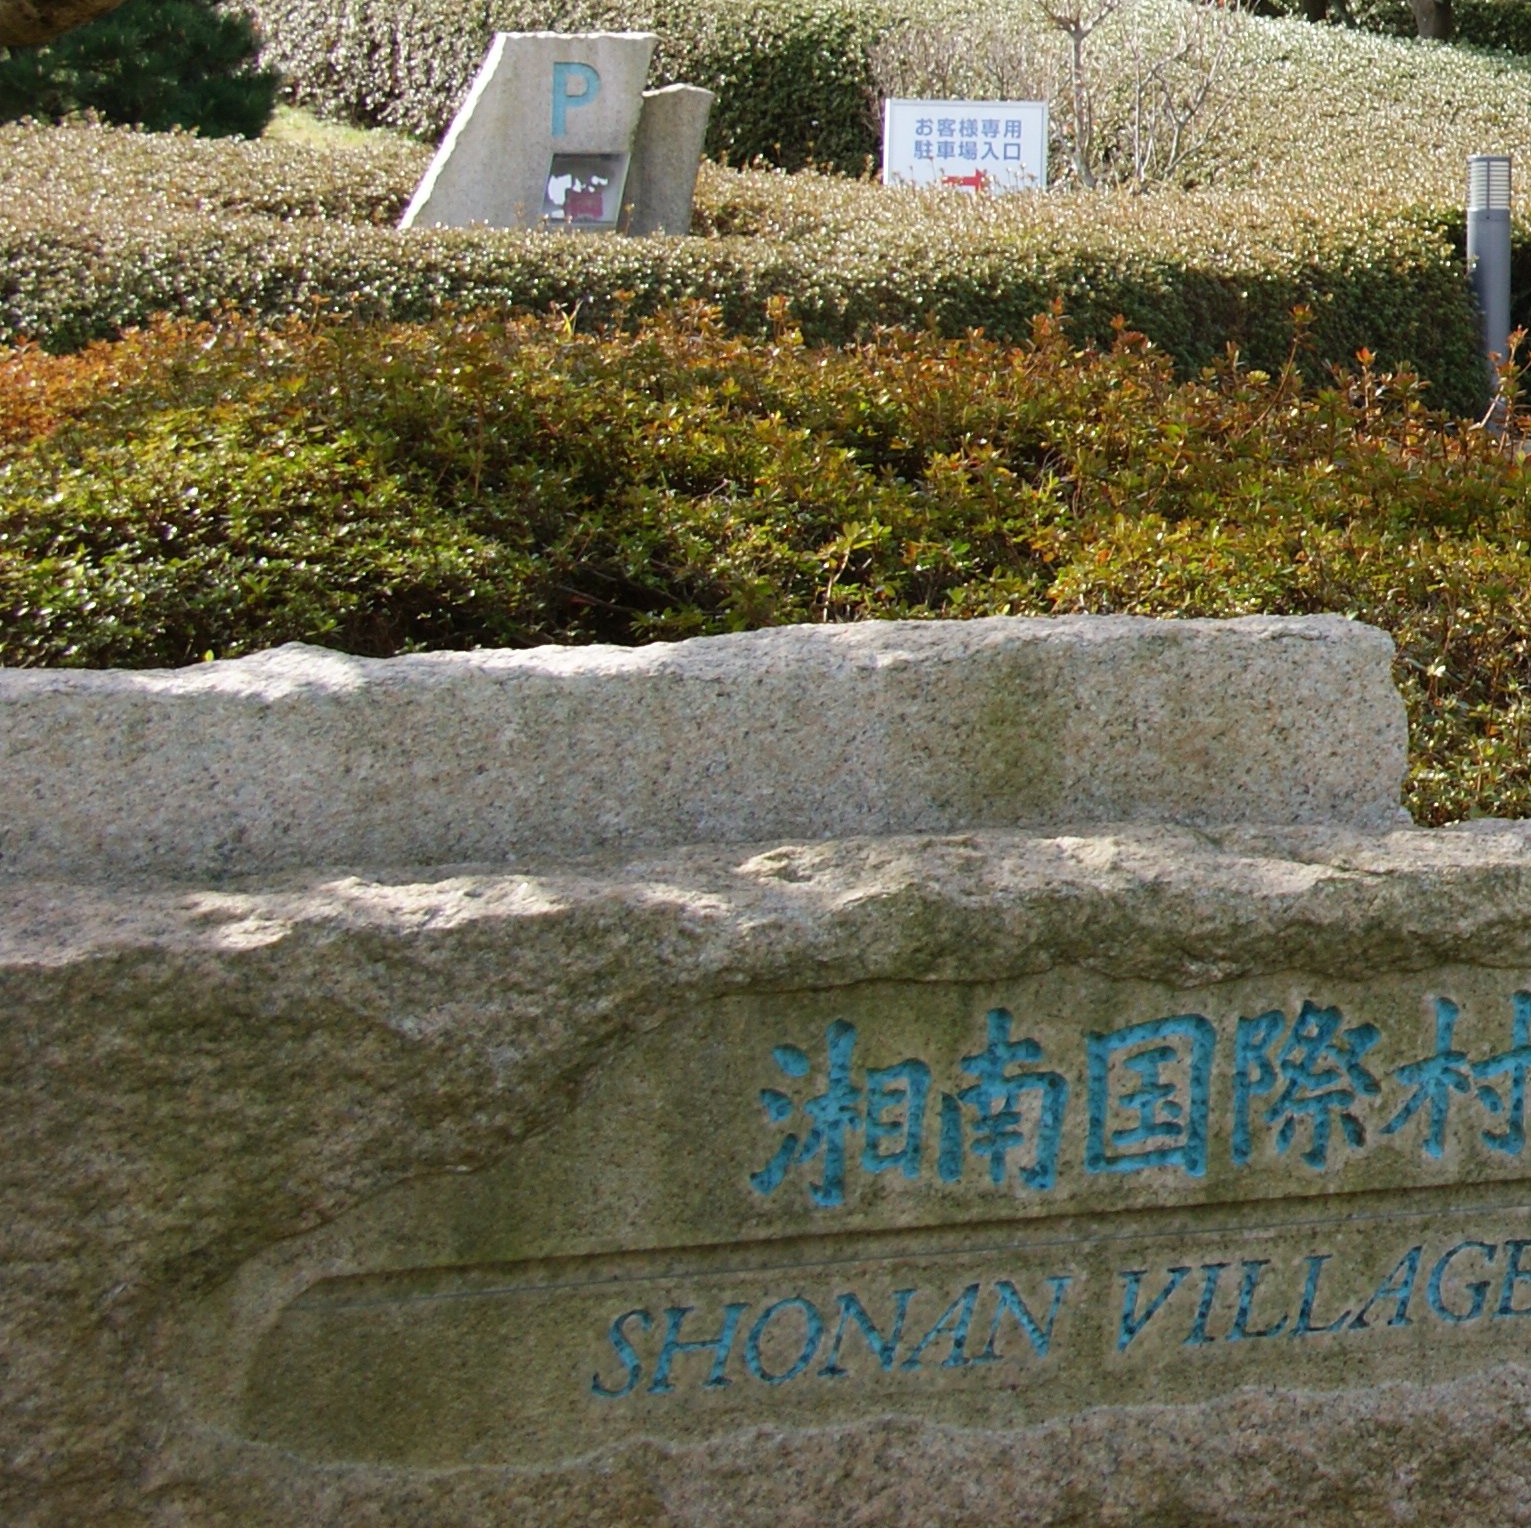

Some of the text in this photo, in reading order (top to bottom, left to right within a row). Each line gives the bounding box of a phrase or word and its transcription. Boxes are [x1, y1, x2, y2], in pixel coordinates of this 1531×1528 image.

[551, 61, 600, 137] P
[914, 140, 1021, 161] 駐車場入口
[915, 117, 1022, 139] お客様専用
[590, 1274, 1072, 1399] SHONAN
